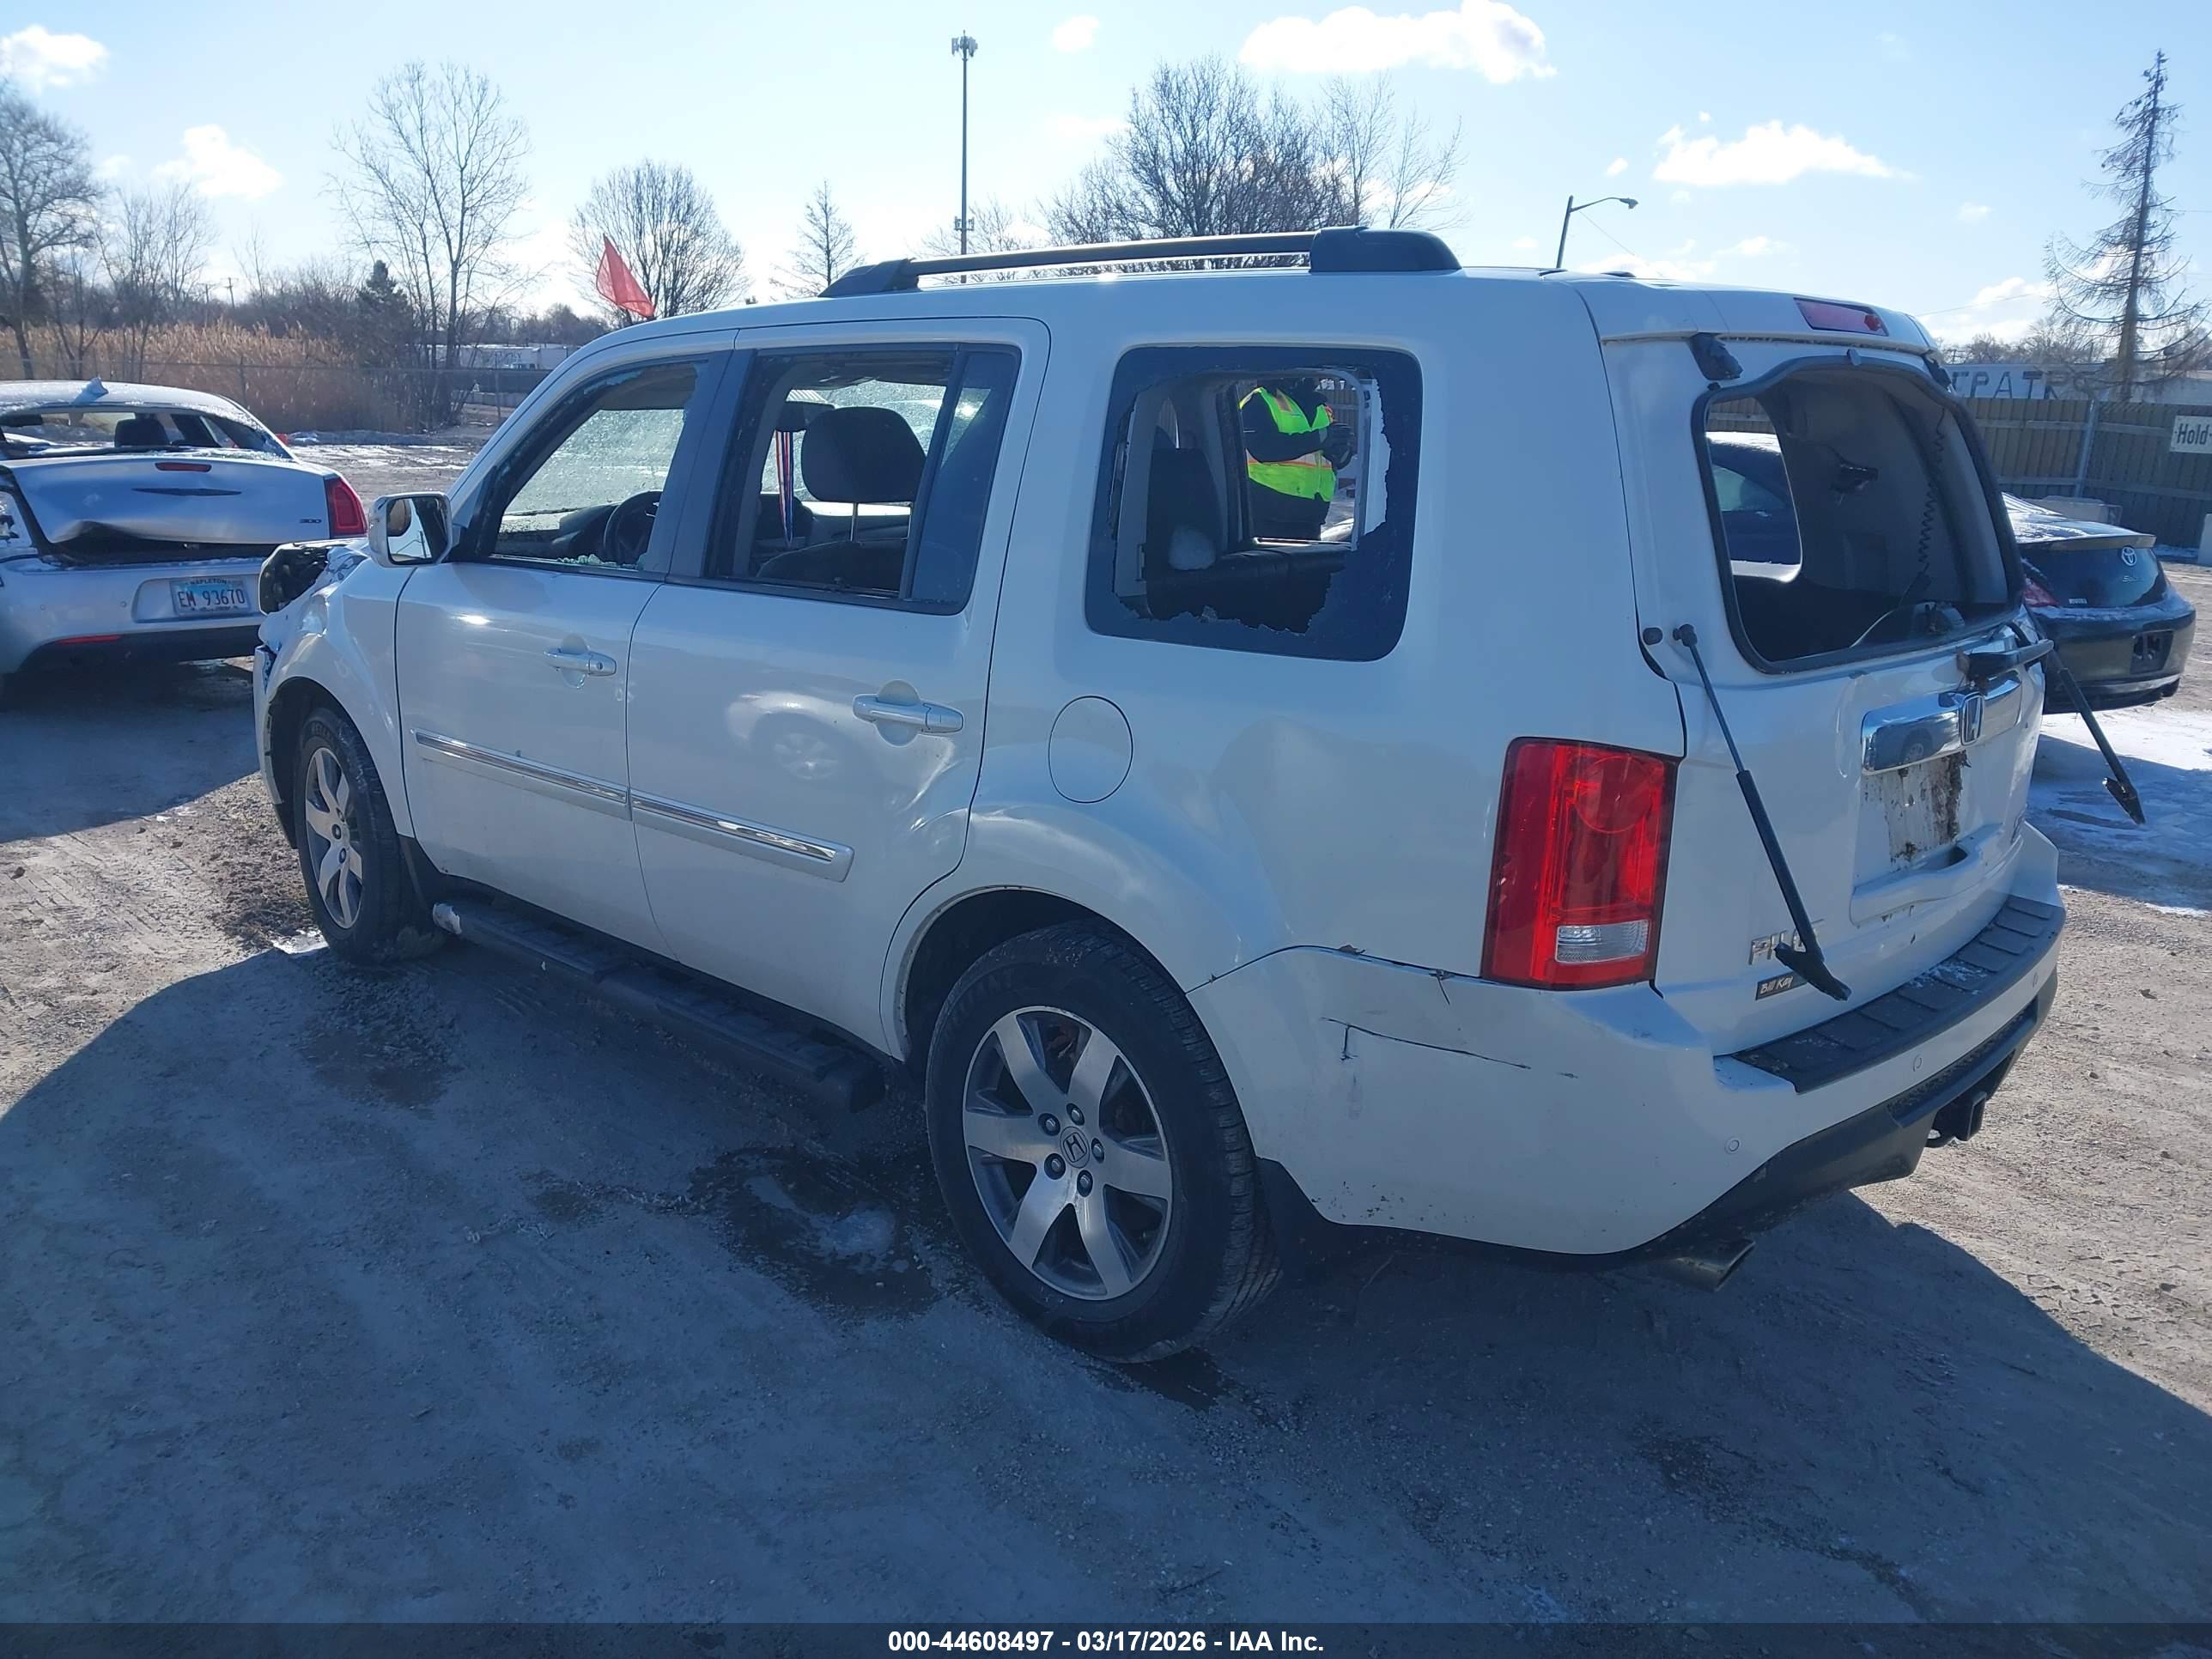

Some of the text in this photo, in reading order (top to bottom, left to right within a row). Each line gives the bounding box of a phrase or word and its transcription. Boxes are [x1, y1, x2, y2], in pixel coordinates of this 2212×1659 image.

[2177, 423, 2210, 445] Hold
[178, 588, 246, 607] EM 93670
[1760, 976, 1793, 994] Bill Kay
